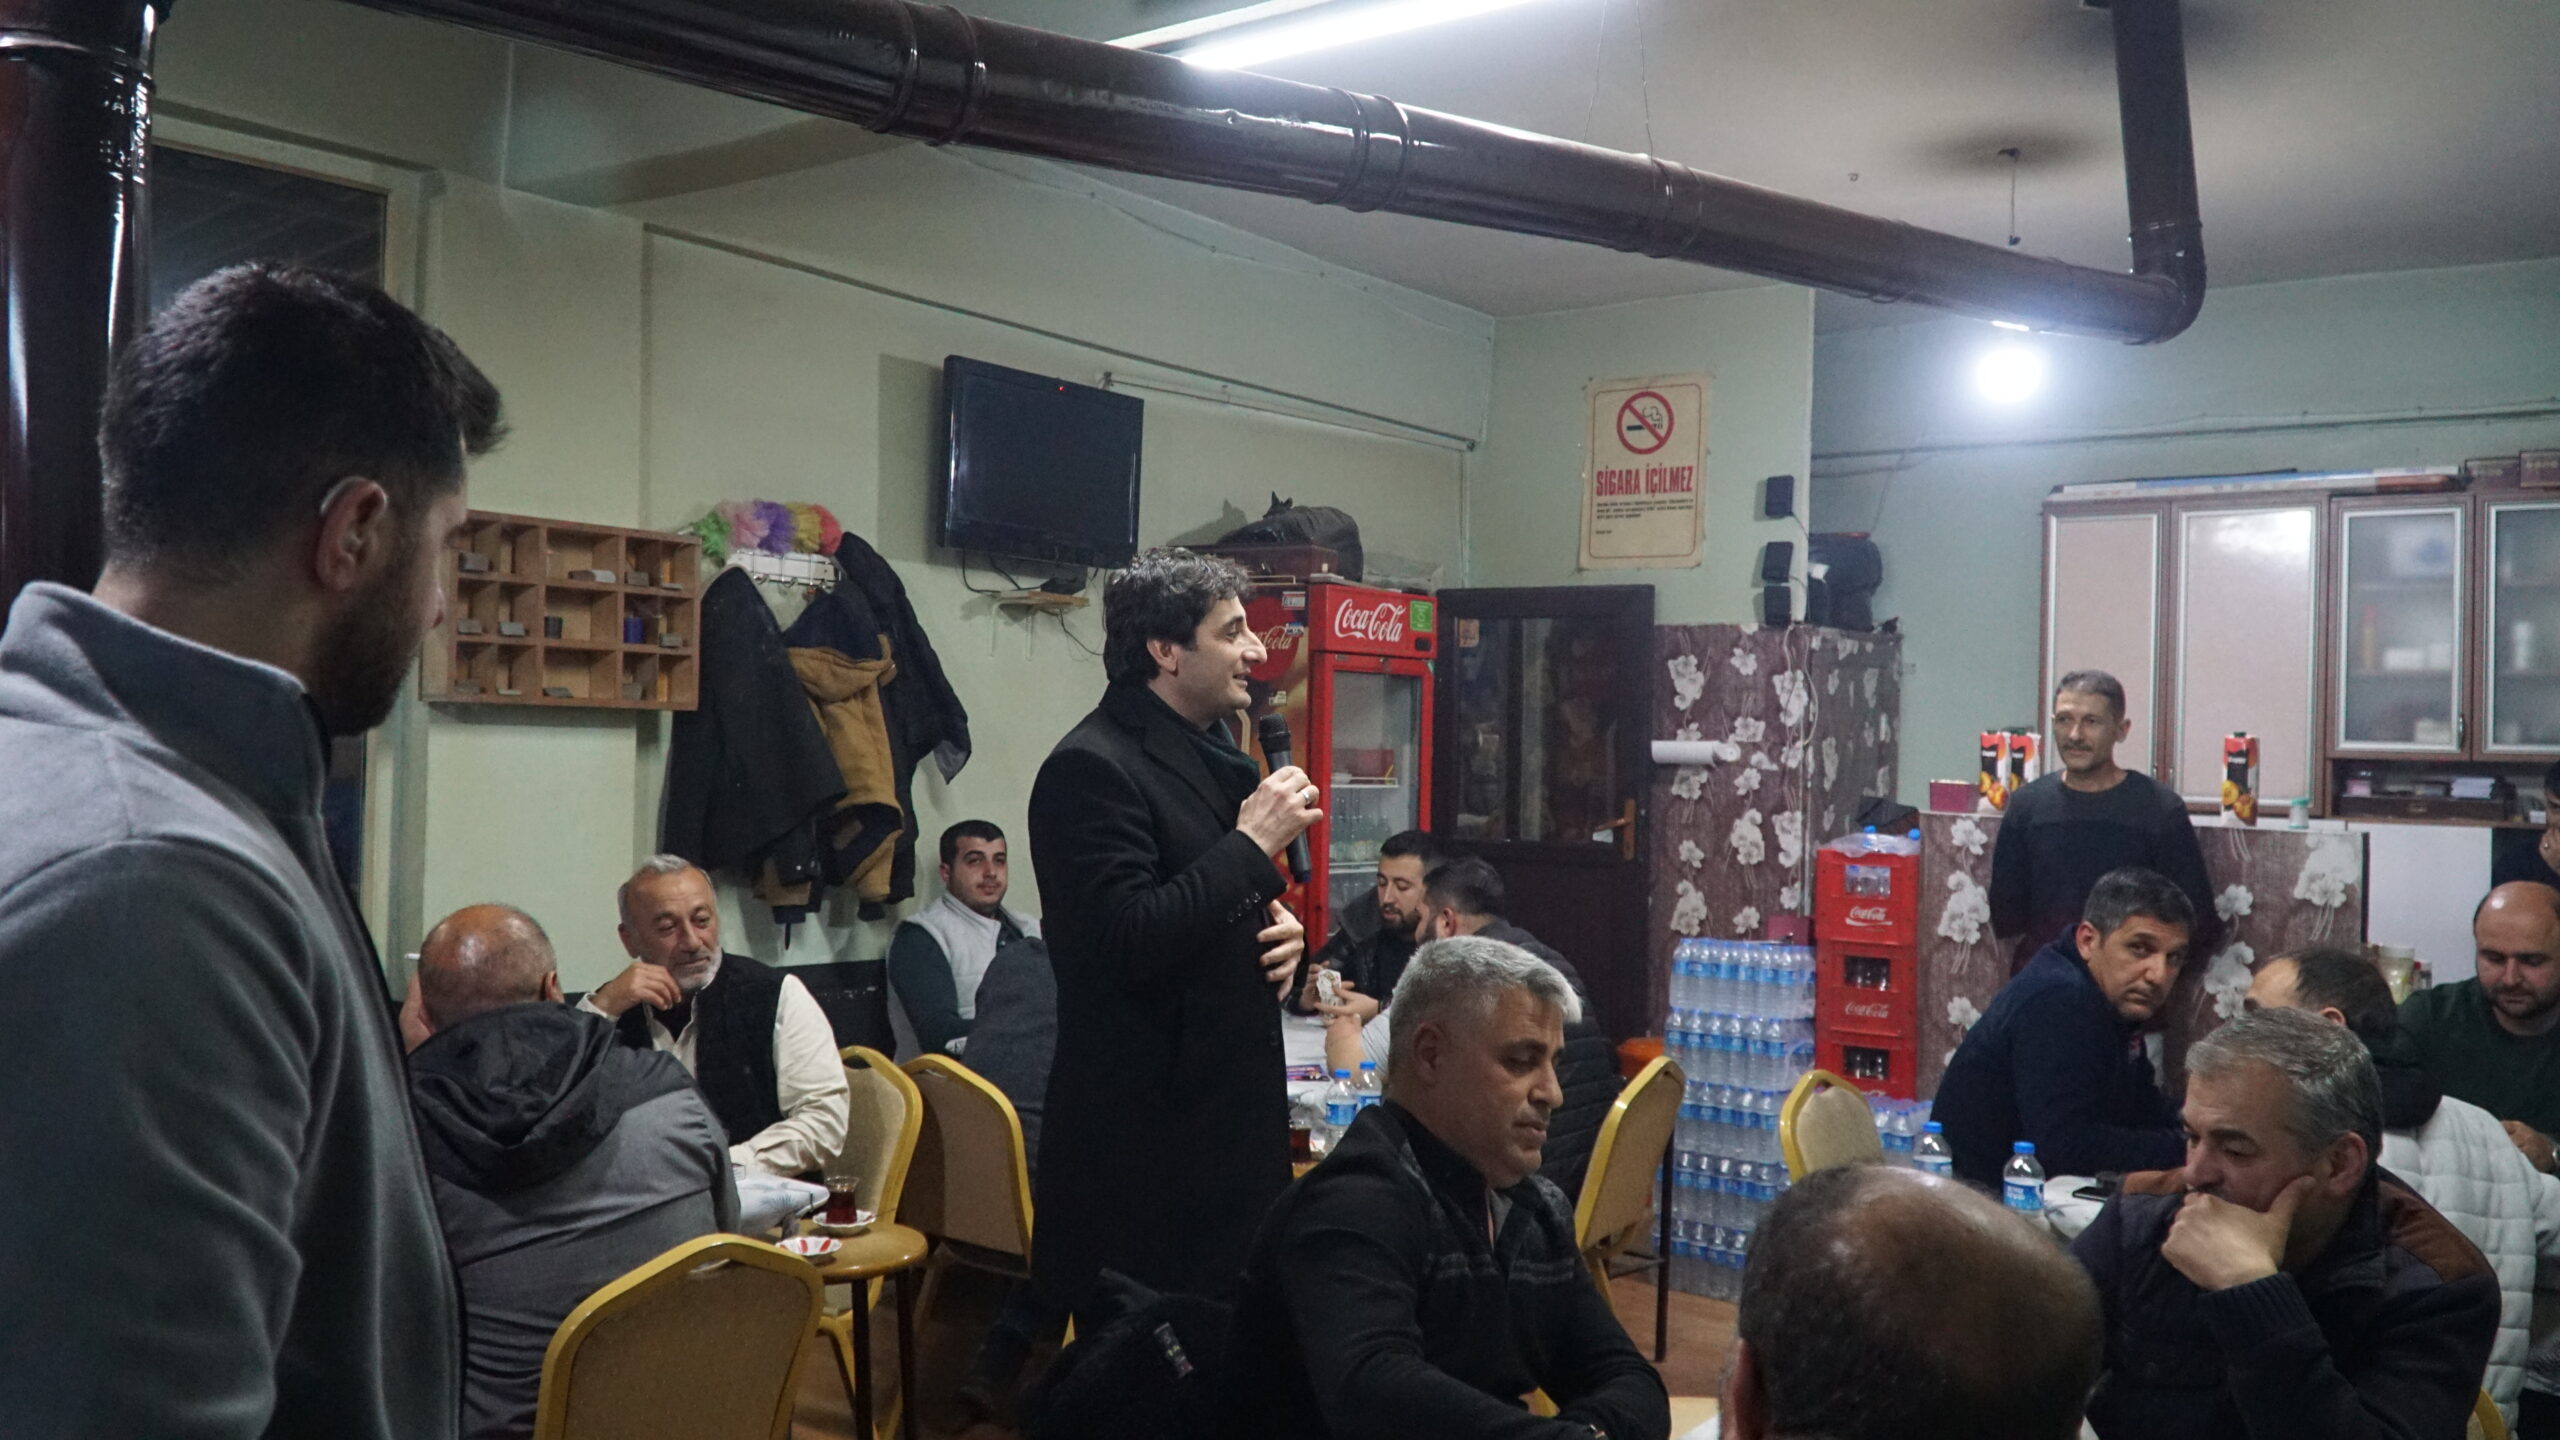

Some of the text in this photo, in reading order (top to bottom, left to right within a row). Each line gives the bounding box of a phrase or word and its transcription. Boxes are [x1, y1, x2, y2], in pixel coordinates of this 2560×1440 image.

[1596, 462, 1693, 497] SİGARA İÇİLMEZ
[1334, 598, 1407, 643] Coca-Cola
